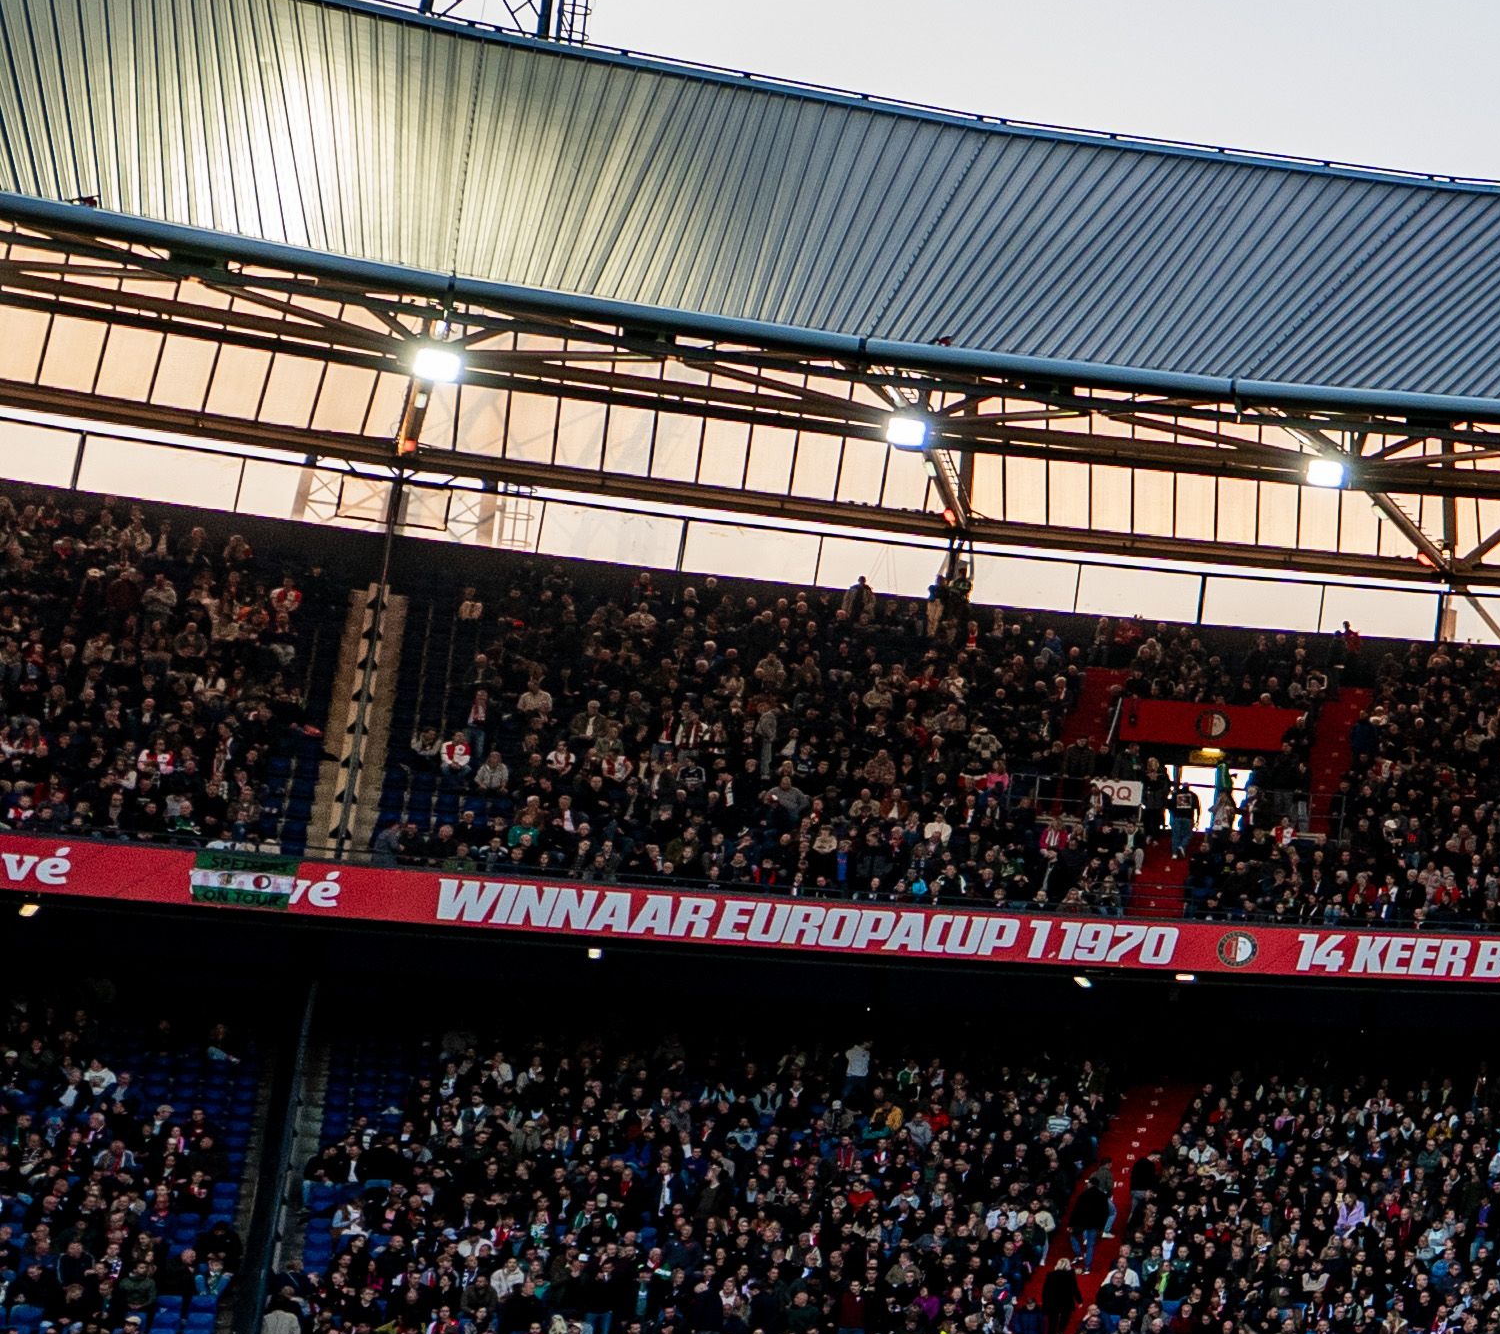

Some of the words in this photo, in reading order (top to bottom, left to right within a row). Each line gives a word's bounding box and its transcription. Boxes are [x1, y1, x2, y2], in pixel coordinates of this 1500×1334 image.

[436, 878, 716, 939] WINNAAR
[712, 900, 1021, 956] EUROPACUP
[1058, 921, 1180, 965] 1970
[1295, 933, 1345, 972] 14
[1348, 935, 1470, 977] KEER
